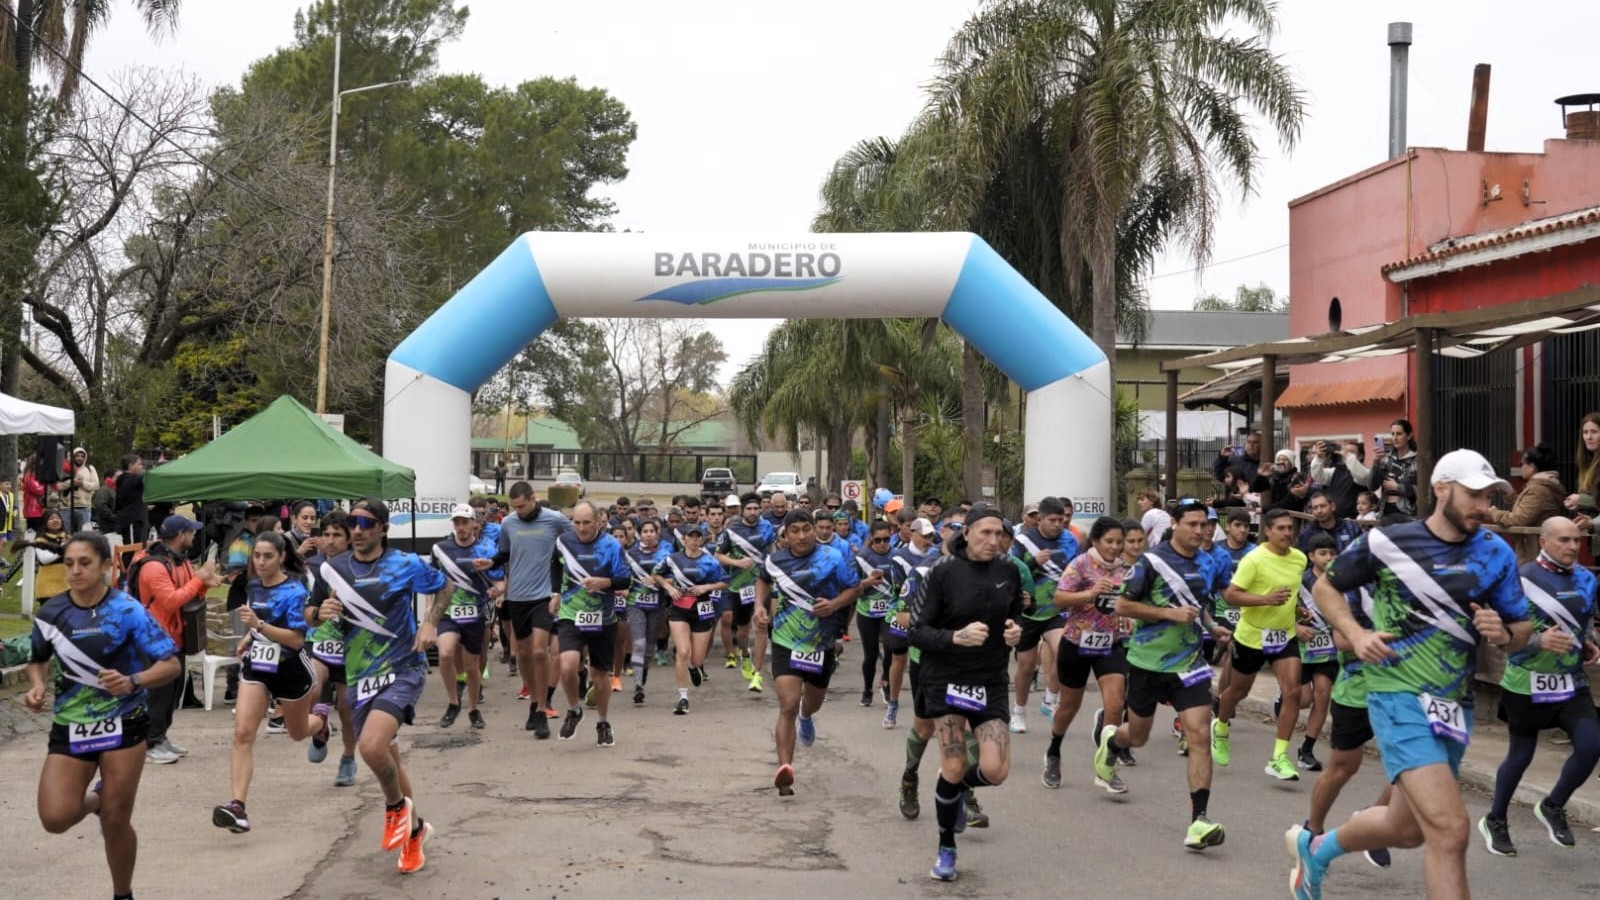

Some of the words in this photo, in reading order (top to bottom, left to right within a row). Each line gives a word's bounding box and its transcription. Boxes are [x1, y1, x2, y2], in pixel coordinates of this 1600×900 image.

[654, 252, 842, 277] BARADERO
[638, 592, 657, 603] 461
[453, 606, 475, 617] 513
[872, 601, 889, 610] 49
[578, 613, 600, 624] 507
[1084, 632, 1111, 648] 472
[1265, 630, 1287, 643] 418
[1310, 636, 1330, 648] 503
[251, 645, 275, 661] 510
[317, 641, 344, 655] 482
[1536, 674, 1568, 691] 501
[1427, 701, 1460, 727] 431
[75, 718, 117, 738] 428
